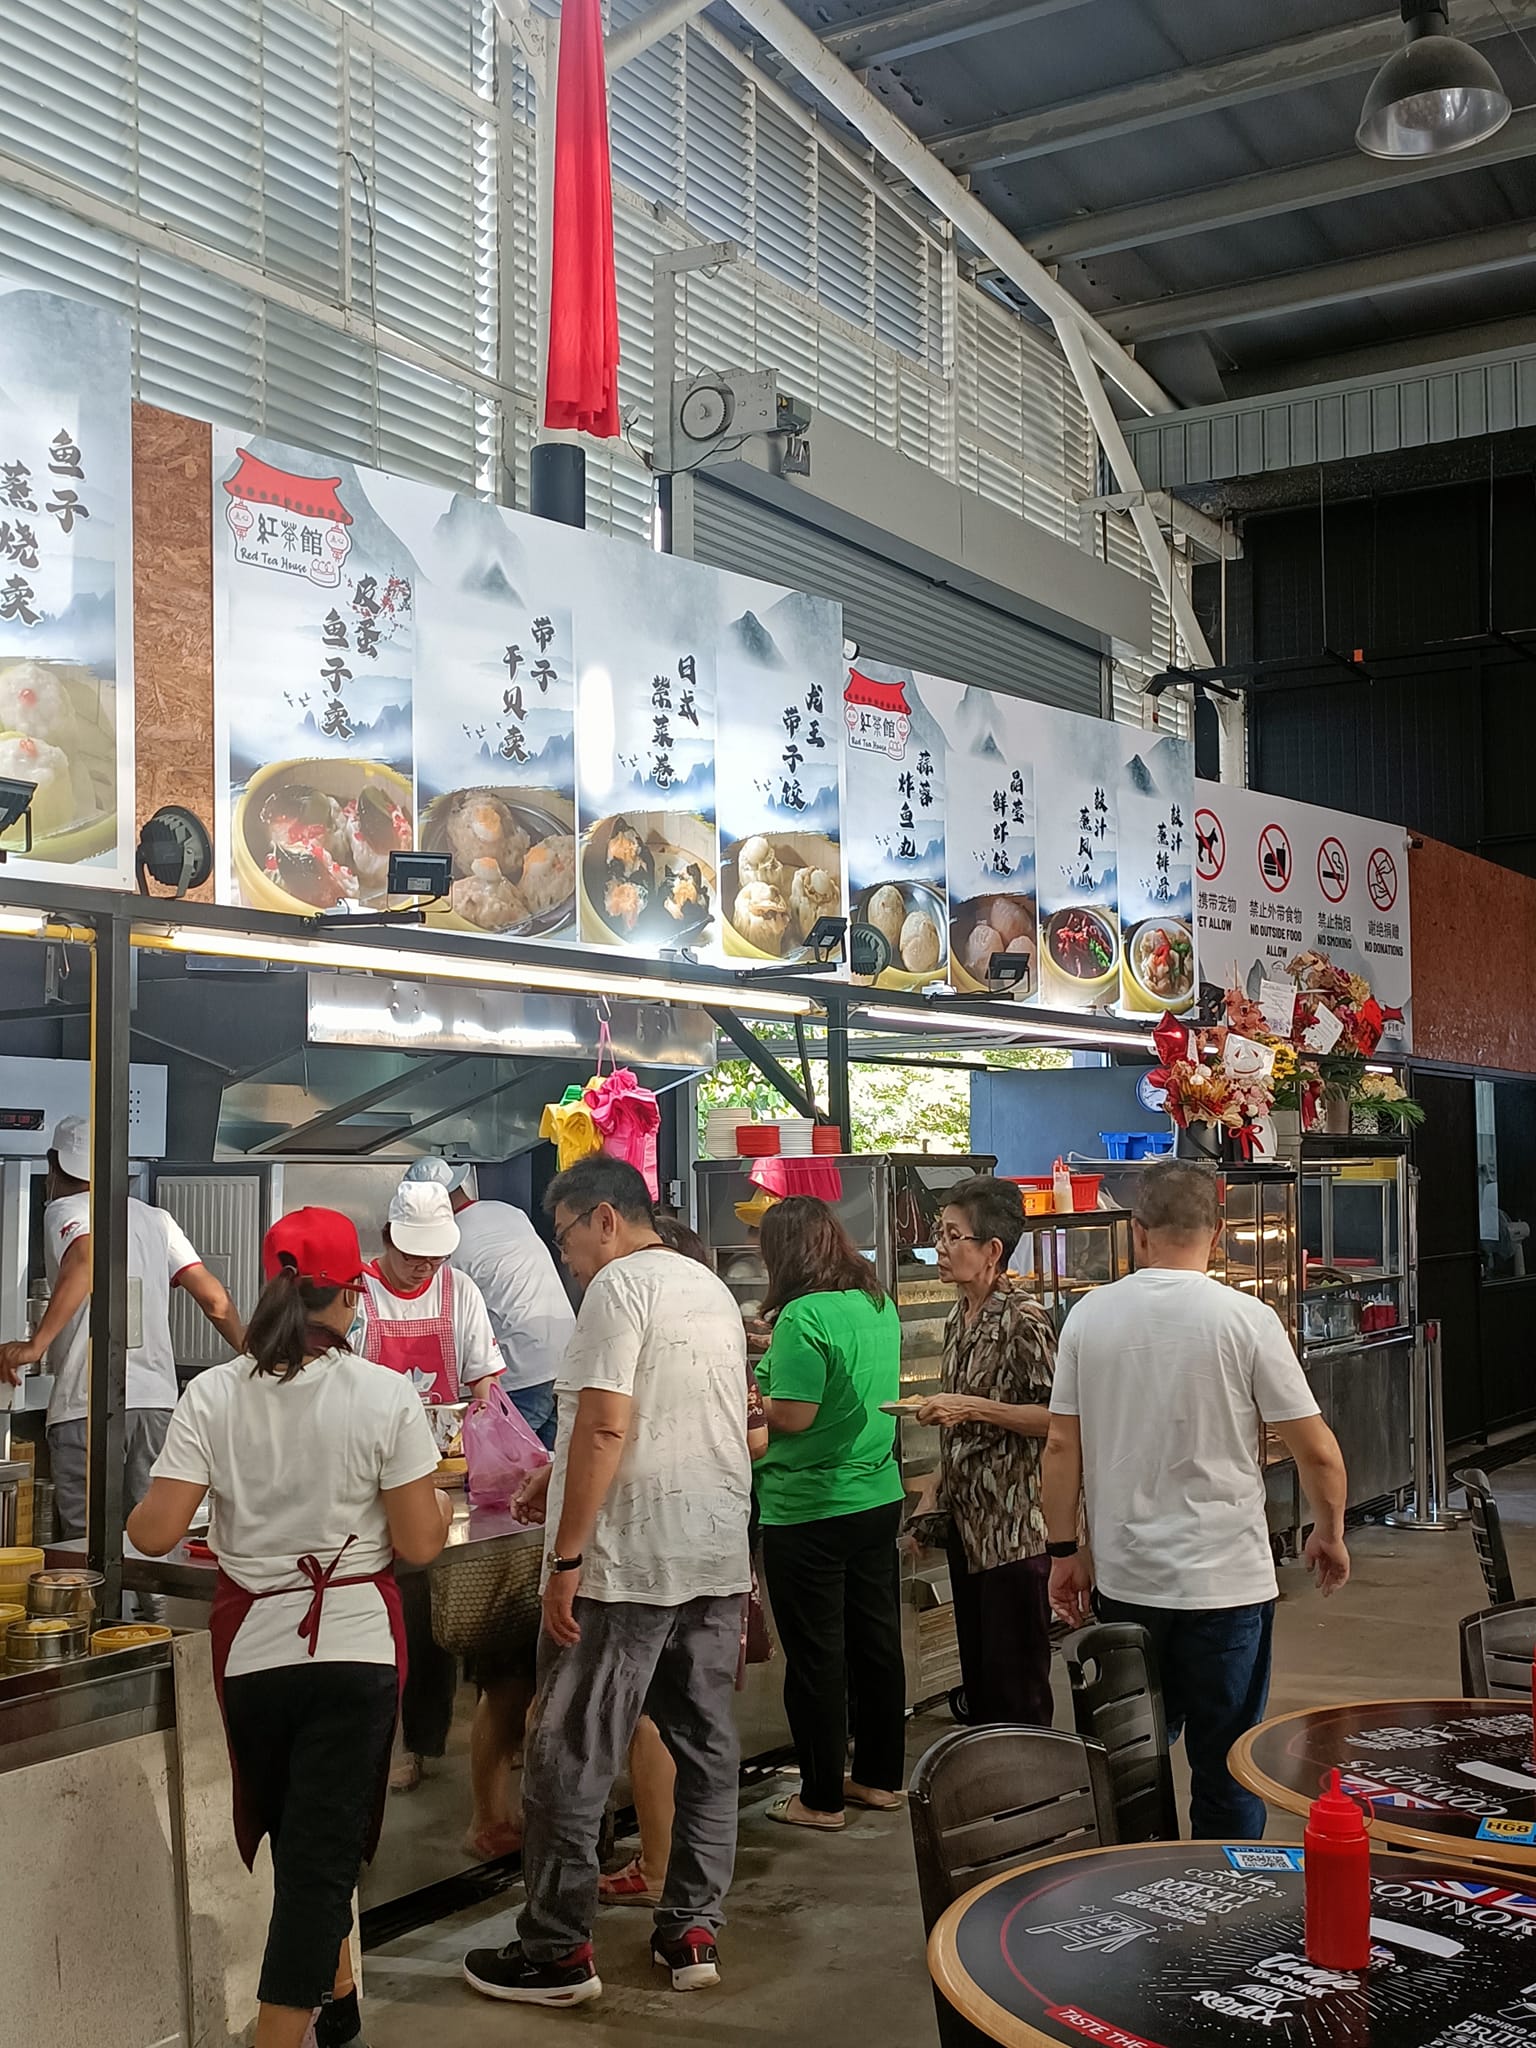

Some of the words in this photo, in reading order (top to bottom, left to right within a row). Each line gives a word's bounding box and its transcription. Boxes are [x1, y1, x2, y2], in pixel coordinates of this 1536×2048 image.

[46, 428, 90, 534] 鱼子
[0, 460, 41, 626] 蒸烧卖
[257, 512, 323, 556] 紅茶館
[240, 547, 258, 562] Red
[262, 553, 278, 566] Tea
[281, 557, 307, 573] House
[353, 574, 382, 658] 皮蛋
[531, 616, 557, 691] 带子
[321, 608, 352, 738] 鱼子卖
[502, 645, 528, 761] 干贝卖
[678, 655, 699, 727] 日式
[652, 674, 675, 787] 紫菜卷
[806, 682, 825, 748] 龙王
[860, 712, 895, 738] 紅茶館
[782, 707, 806, 810] 带子饺
[1010, 770, 1024, 824] 晶莹
[898, 771, 915, 857] 炸鱼丸
[993, 790, 1010, 875] 鲜虾饺
[1156, 821, 1169, 900] 蒸排骨
[1209, 917, 1231, 931] ALLOW
[1249, 900, 1302, 924] 禁止外带食物
[1250, 924, 1259, 935] NO
[1260, 925, 1285, 940] OUTSIDE
[1287, 929, 1302, 942] FOOD
[1317, 934, 1326, 946] NO
[1327, 935, 1352, 949] SMOKING
[1364, 941, 1373, 952] NO
[1373, 942, 1403, 956] DONATIONS
[1266, 945, 1287, 957] ALLOW
[1337, 1760, 1508, 1815] CONNOR'S
[1486, 1821, 1530, 1834] H68
[1148, 1877, 1261, 1905] ROASTY
[1184, 1868, 1287, 1899] CONNOR'S
[1138, 1885, 1243, 1914] UNDERTONES
[1441, 1915, 1525, 1941] PORTER
[1240, 1986, 1284, 2001] AND
[1270, 1975, 1335, 1998] DRINK
[1058, 2008, 1110, 2035] TASTE
[1468, 2012, 1528, 2034] INSPIRED
